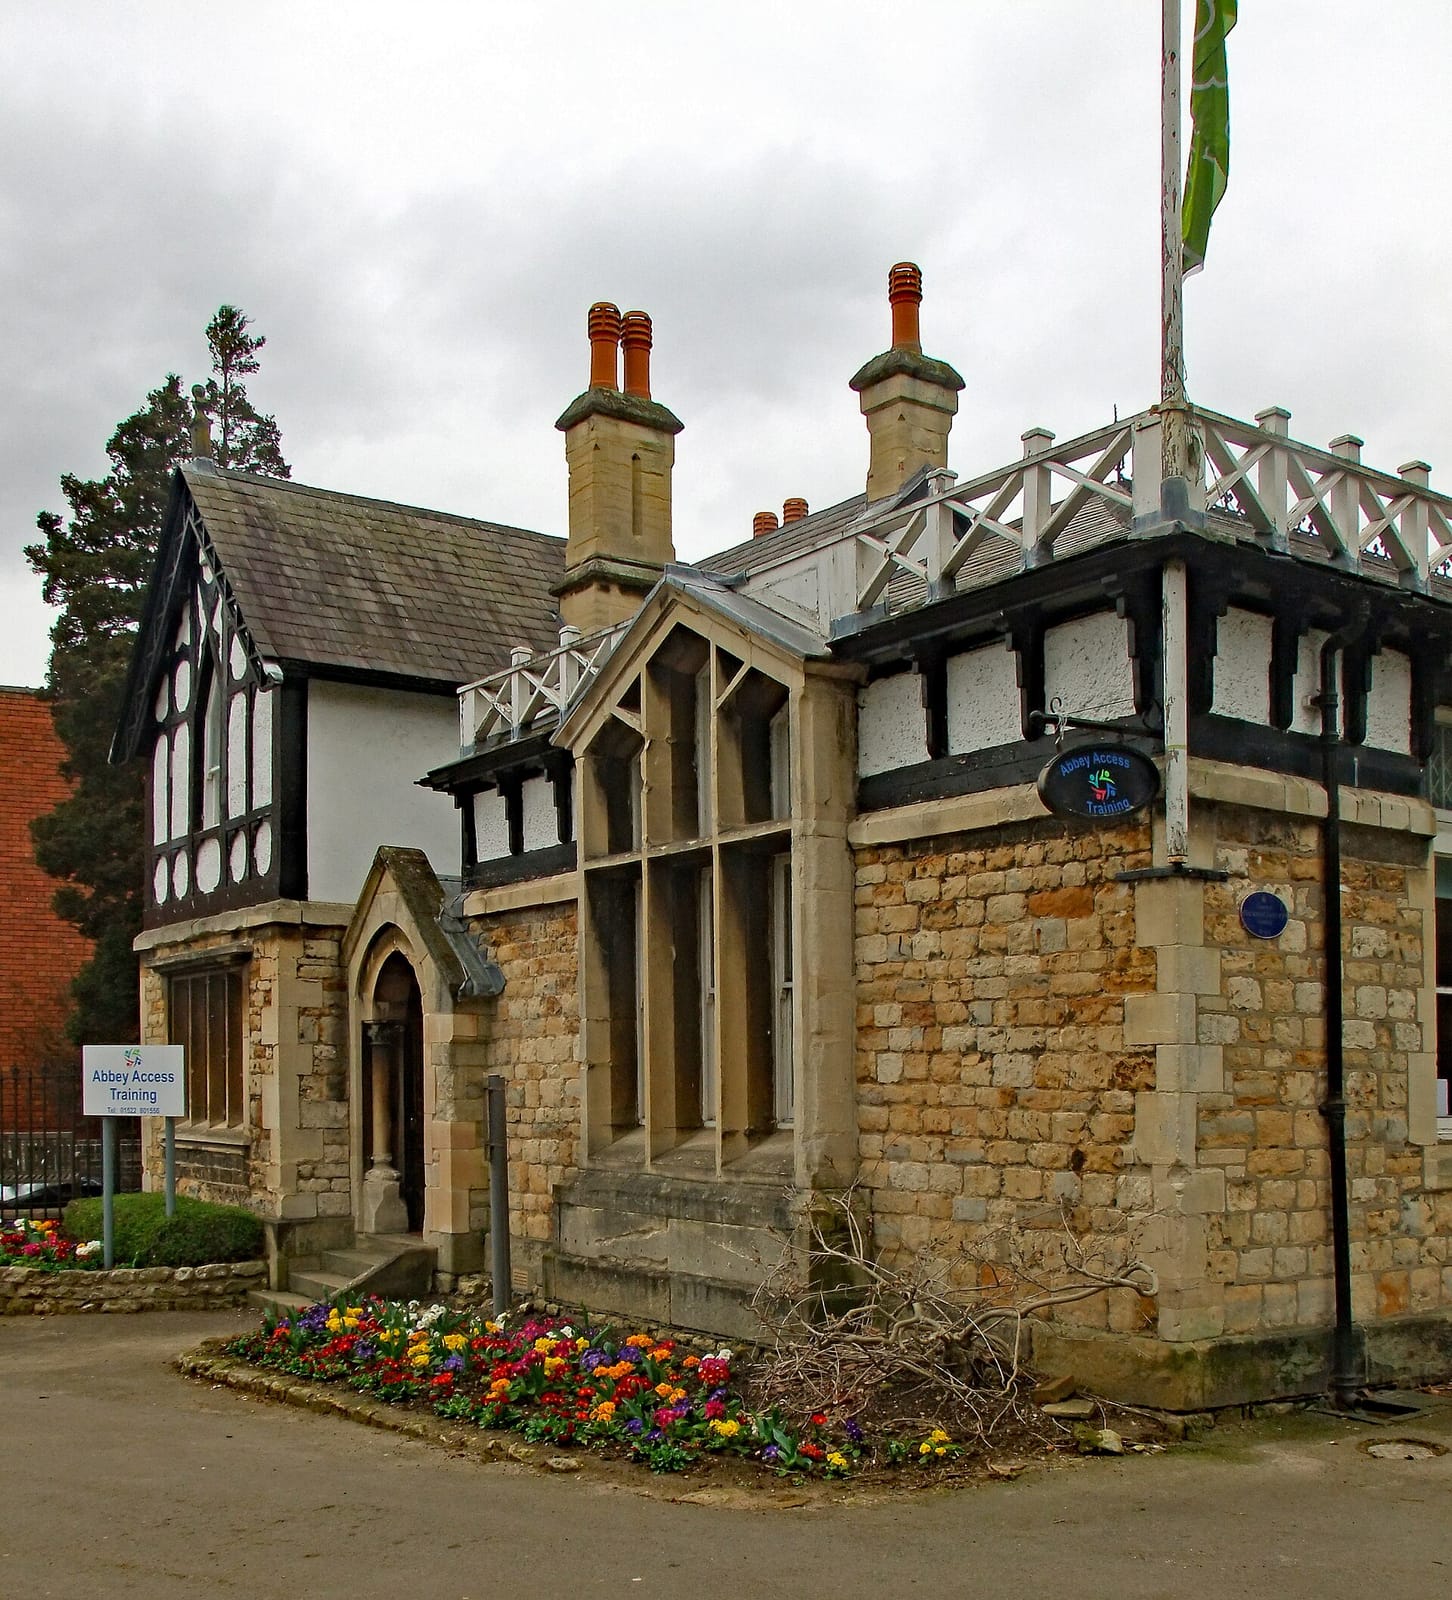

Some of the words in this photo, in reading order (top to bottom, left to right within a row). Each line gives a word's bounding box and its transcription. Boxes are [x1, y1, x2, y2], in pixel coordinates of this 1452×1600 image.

[1060, 755, 1090, 776] Abbey
[1093, 752, 1130, 768] Access
[1086, 798, 1130, 814] Training
[92, 1070, 129, 1085] Abbey
[132, 1070, 175, 1082] Access
[110, 1088, 157, 1104] Training
